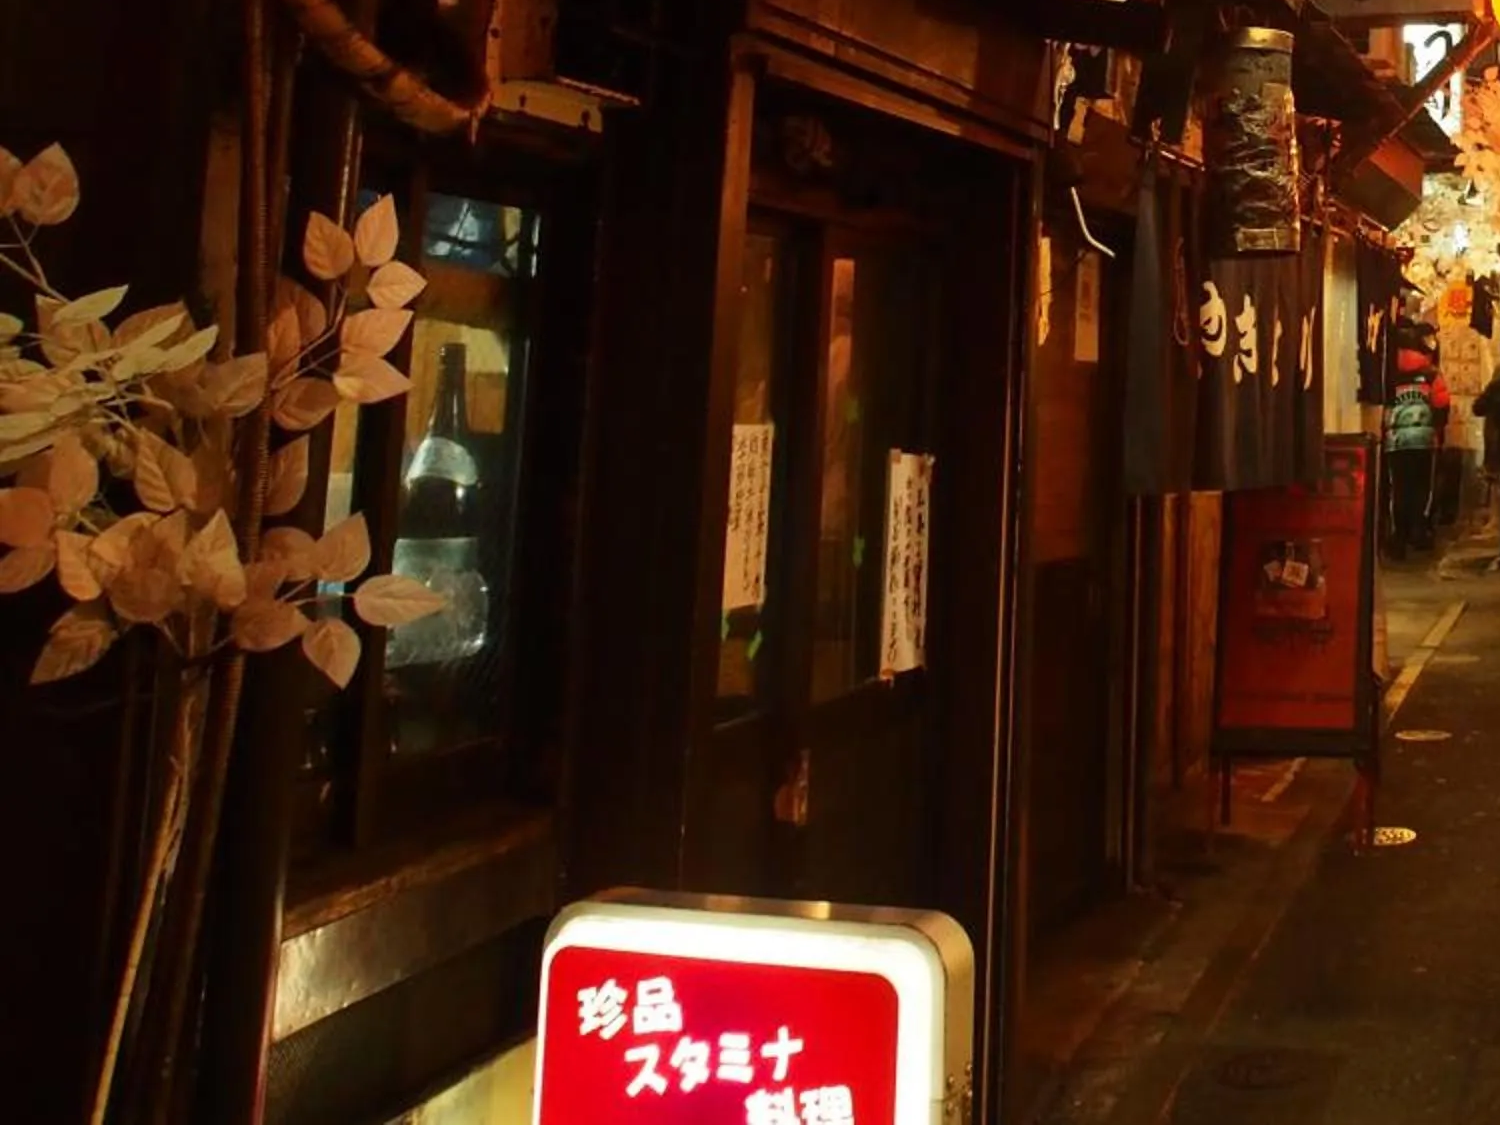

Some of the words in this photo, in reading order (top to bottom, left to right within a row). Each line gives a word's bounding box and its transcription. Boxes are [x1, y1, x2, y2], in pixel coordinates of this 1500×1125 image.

[576, 974, 684, 1041] 珍品
[623, 1024, 805, 1099] スタミナ
[744, 1084, 856, 1125] 料理
